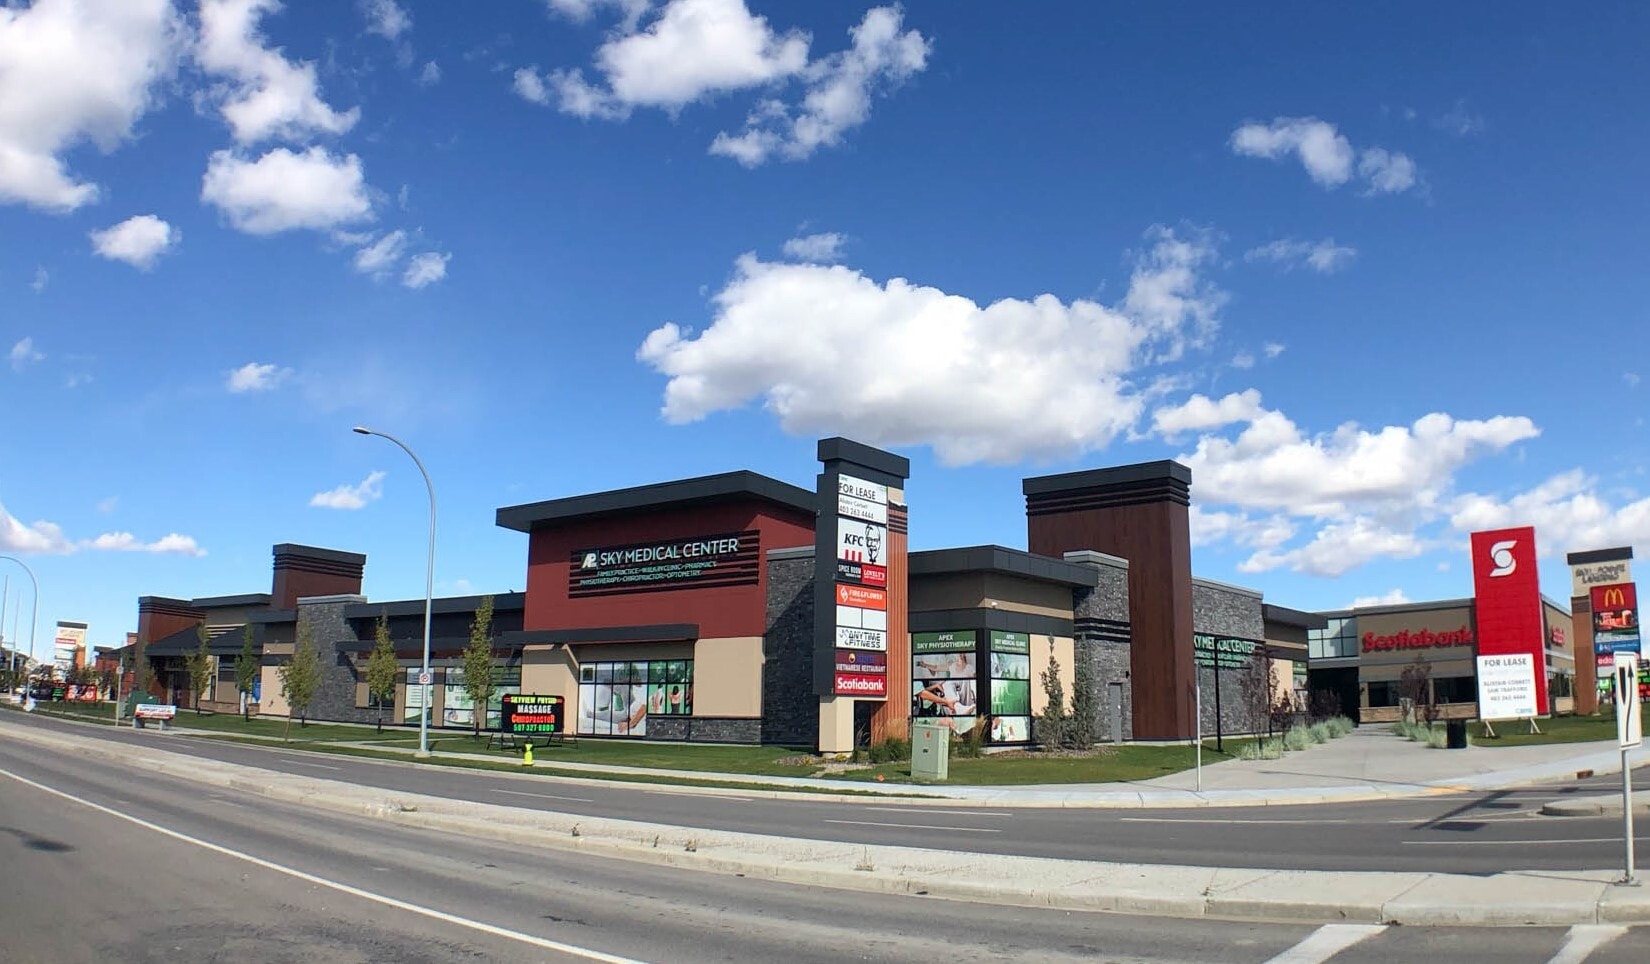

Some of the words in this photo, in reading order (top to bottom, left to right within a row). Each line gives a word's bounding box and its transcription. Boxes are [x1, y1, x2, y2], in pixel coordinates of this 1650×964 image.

[838, 482, 854, 494] FOR
[856, 487, 876, 500] LEASE
[844, 533, 865, 547] KFC
[600, 550, 627, 567] SKY
[627, 544, 682, 564] MEDICAL
[682, 538, 740, 558] CENTER
[685, 561, 717, 571] PHARMACY
[580, 576, 620, 586] PHYSIOTHERAPY
[623, 573, 666, 583] CHIROPRACTOR
[667, 570, 703, 580] OPTOMETRY
[850, 639, 881, 649] FITNESS
[928, 640, 977, 650] PHYSIOTHERAPY
[1362, 626, 1475, 651] Scotiabank
[1485, 659, 1501, 667] FOR
[1503, 658, 1527, 667] LEASE
[837, 677, 884, 691] Scotiabank
[517, 704, 552, 714] MASSAGE
